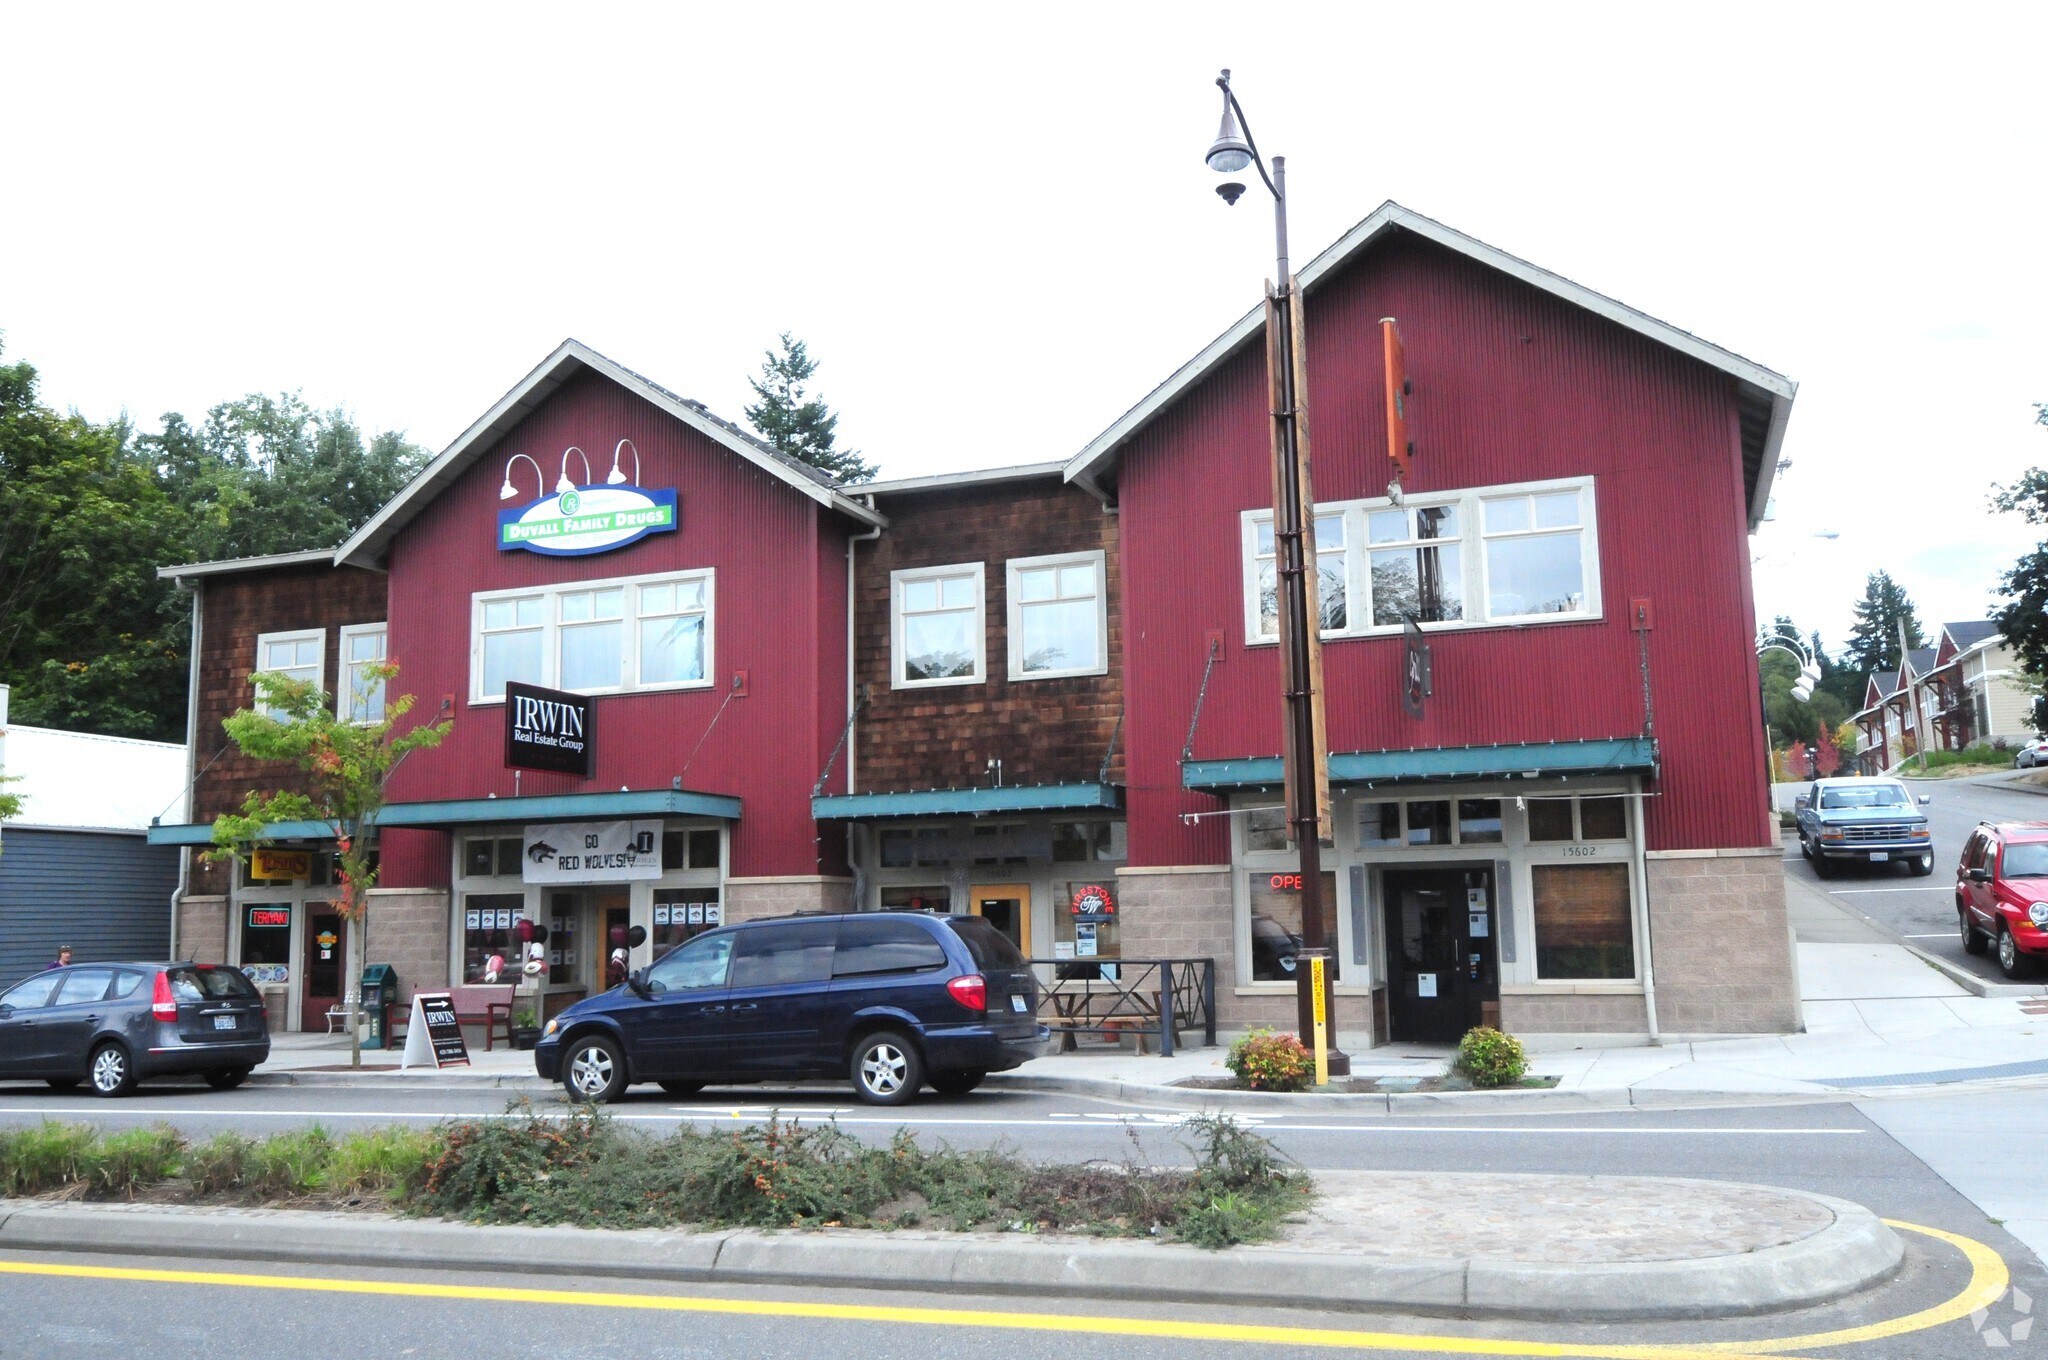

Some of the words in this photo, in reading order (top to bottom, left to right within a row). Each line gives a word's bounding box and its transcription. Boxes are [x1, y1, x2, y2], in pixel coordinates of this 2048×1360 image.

[509, 523, 559, 539] DUVALL
[563, 516, 611, 533] FAMILY
[615, 510, 664, 527] DRUGS
[514, 695, 584, 738] IRWIN
[514, 729, 532, 743] Real
[534, 732, 558, 746] Estate
[559, 736, 584, 753] Group
[585, 834, 598, 849] GO
[1562, 846, 1596, 857] 15602
[559, 855, 580, 870] RED
[585, 853, 626, 869] WOLVES!
[1270, 874, 1302, 889] OPE
[1072, 885, 1114, 913] FIRESTONE
[252, 911, 288, 925] TERIYAKI
[426, 1010, 456, 1024] IRWIN
